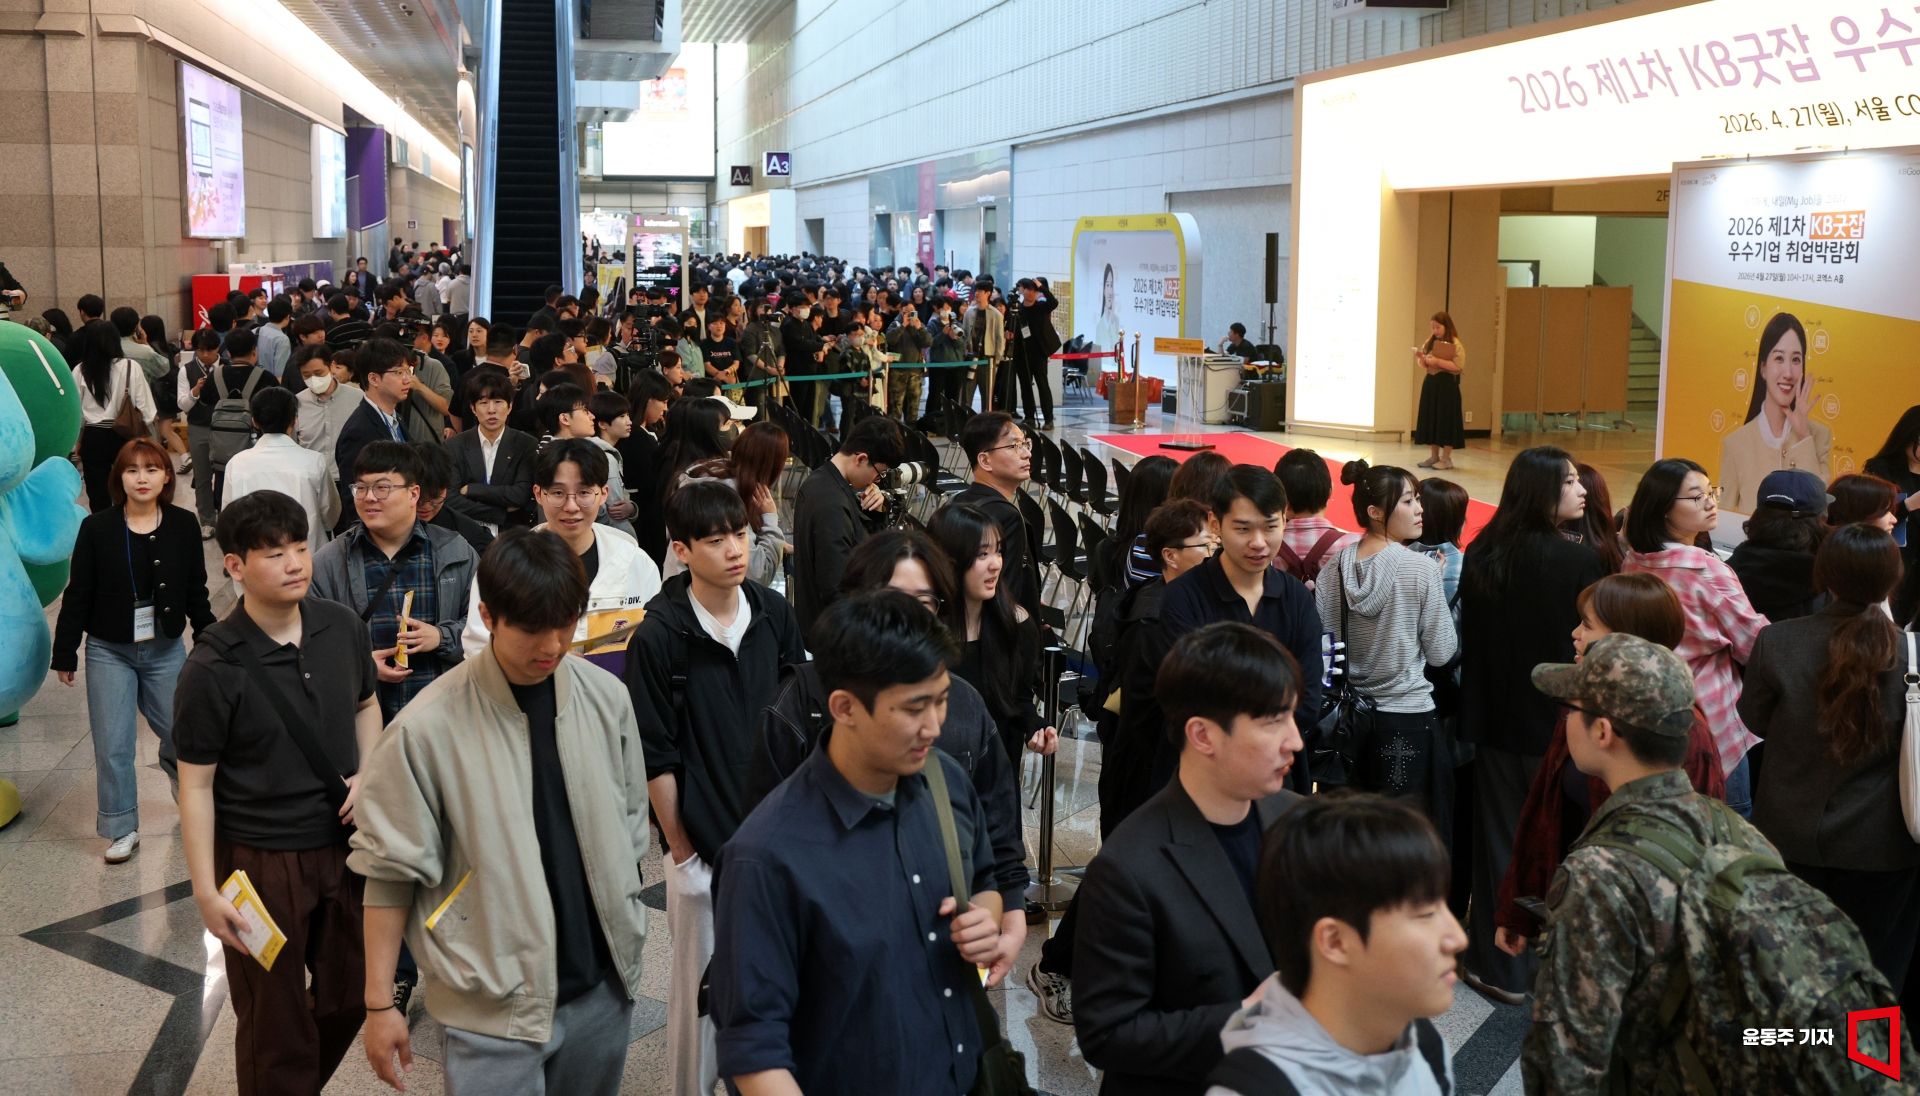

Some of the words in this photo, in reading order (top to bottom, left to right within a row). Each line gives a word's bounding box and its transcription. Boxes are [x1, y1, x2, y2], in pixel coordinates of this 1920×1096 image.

[1508, 66, 1588, 114] 2026
[1587, 49, 1679, 104] 제1차
[1679, 24, 1821, 91] KB굿잡
[1830, 6, 1920, 73] 우수
[1719, 112, 1768, 134] 2026.
[1771, 110, 1789, 128] 4.
[1790, 101, 1852, 127] 27(월),
[1854, 96, 1892, 122] 서울
[767, 155, 789, 174] A3
[732, 168, 750, 184] A4
[1728, 216, 1763, 236] 2026
[1768, 214, 1806, 237] 제1차
[1812, 212, 1864, 238] KB굿잡
[1728, 240, 1781, 263] 우수기업
[1786, 240, 1860, 264] 취업박람회
[1133, 278, 1147, 294] 2026
[1148, 278, 1163, 296] 제1차
[1134, 297, 1154, 315] 우수기업
